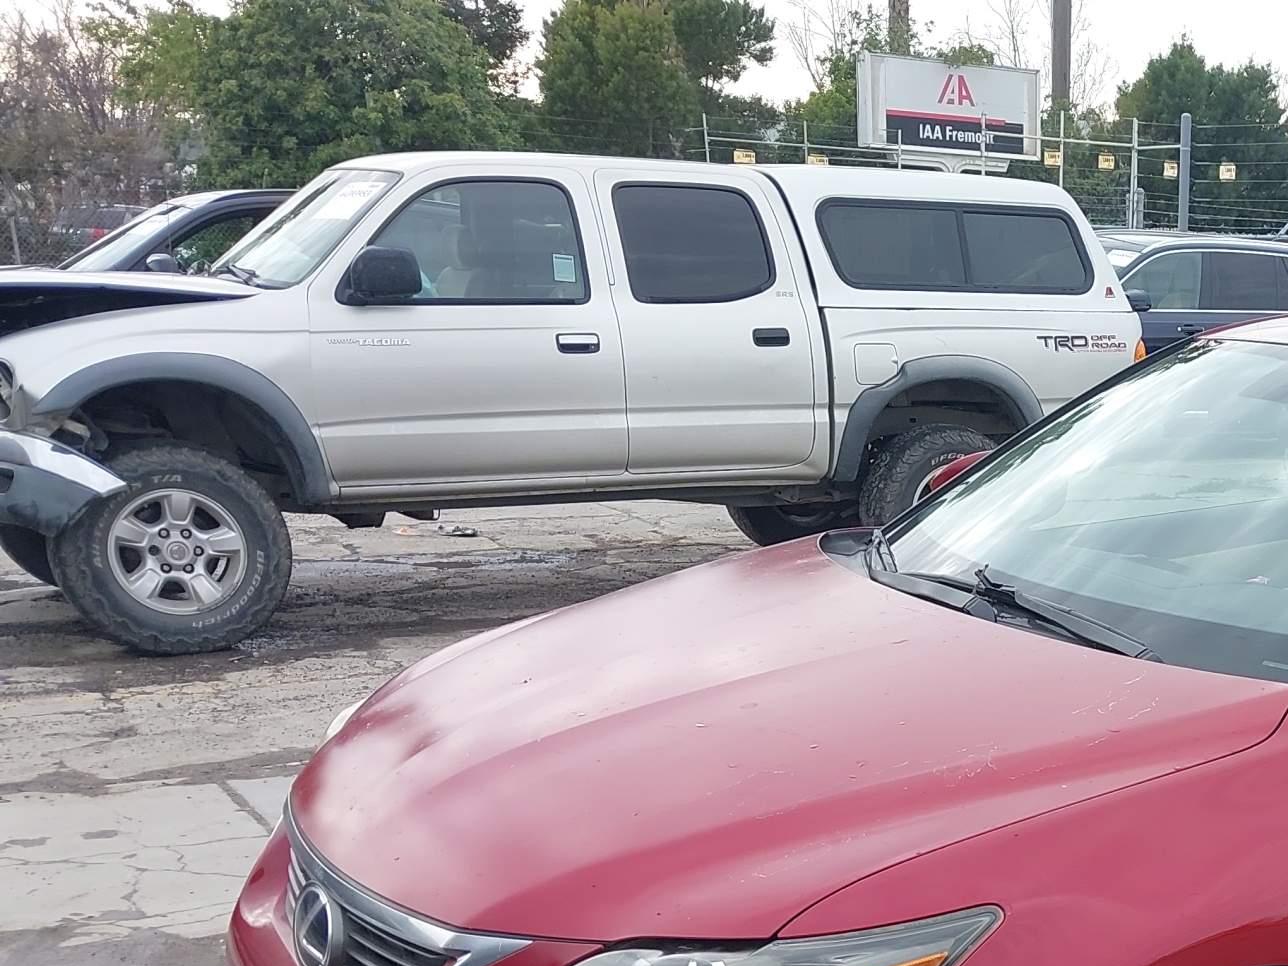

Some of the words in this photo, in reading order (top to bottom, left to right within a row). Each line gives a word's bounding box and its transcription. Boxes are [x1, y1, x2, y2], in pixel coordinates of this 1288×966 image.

[919, 123, 943, 140] IAA
[359, 338, 411, 347] TACOMA
[1036, 335, 1088, 352] TRD
[152, 474, 183, 484] T/A
[192, 549, 266, 629] BFGoodrich
